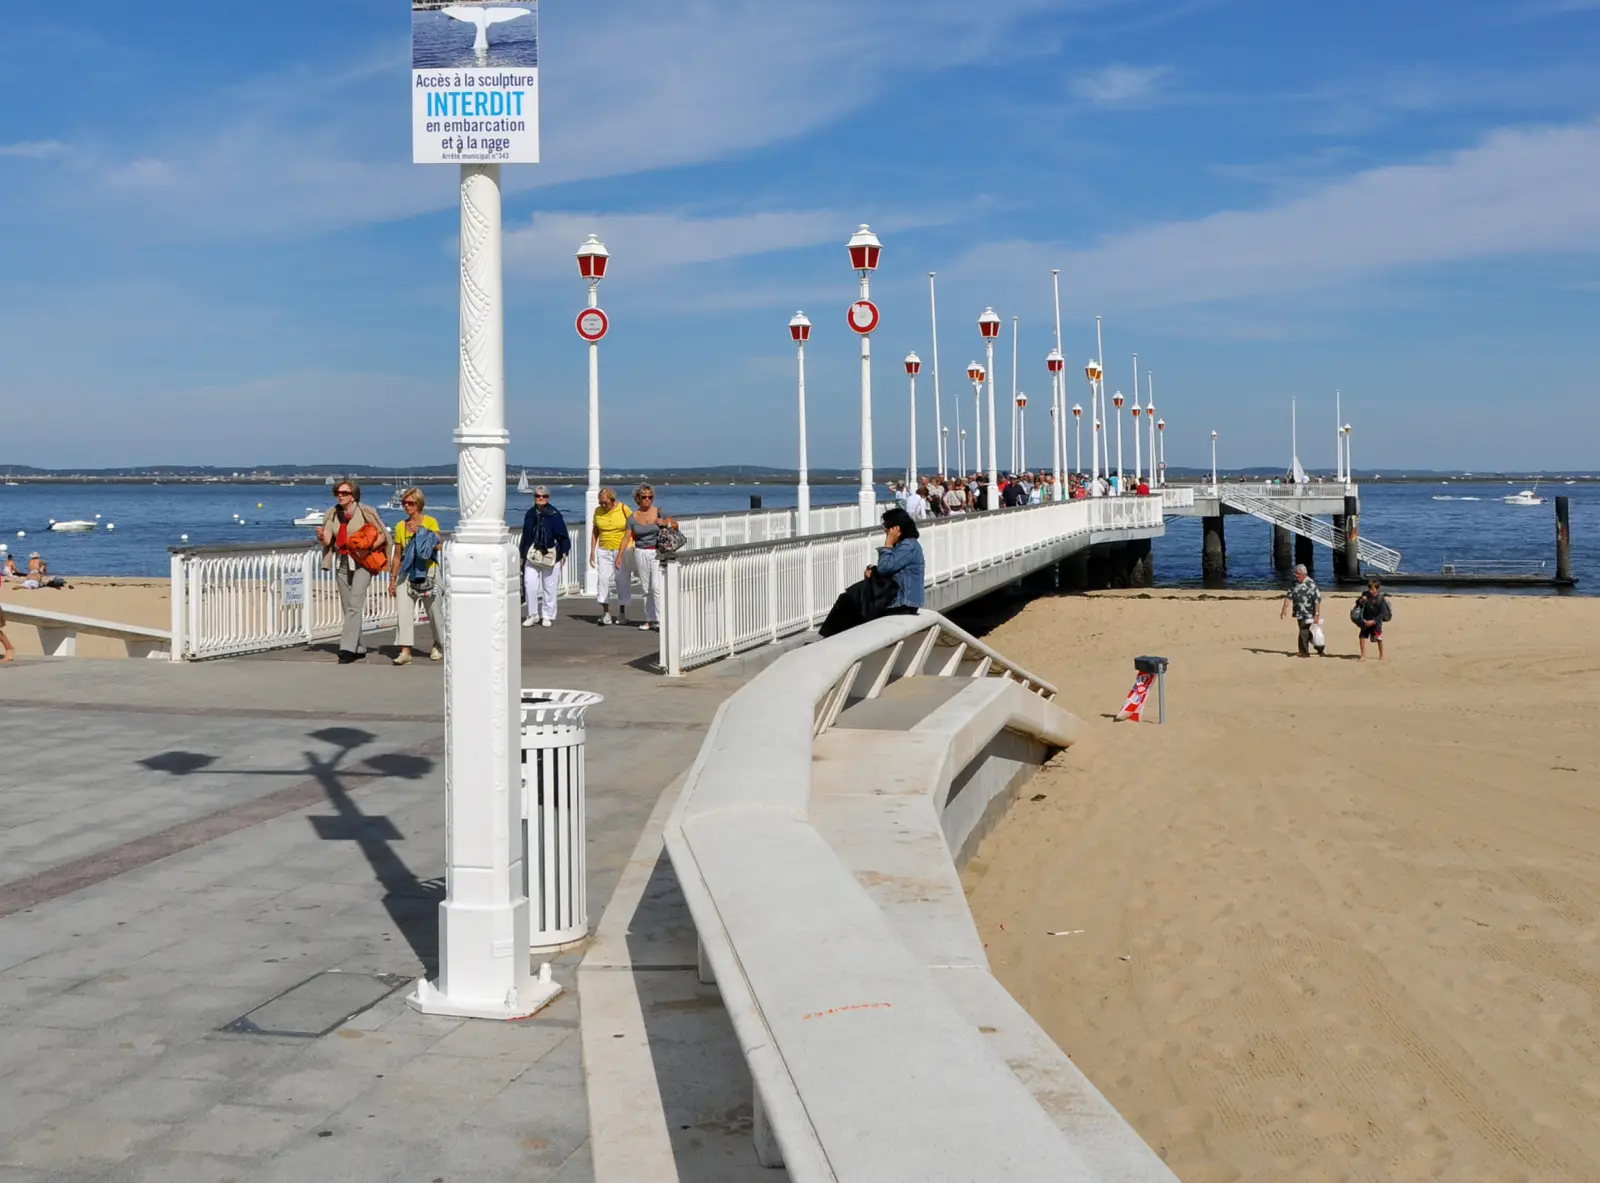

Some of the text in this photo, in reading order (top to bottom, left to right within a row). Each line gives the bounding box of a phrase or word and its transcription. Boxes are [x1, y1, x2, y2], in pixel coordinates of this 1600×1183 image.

[416, 72, 534, 89] Accès à la sculpture
[427, 91, 524, 116] INTERDIT
[426, 118, 525, 132] en embarcation
[442, 135, 510, 151] et à la nage
